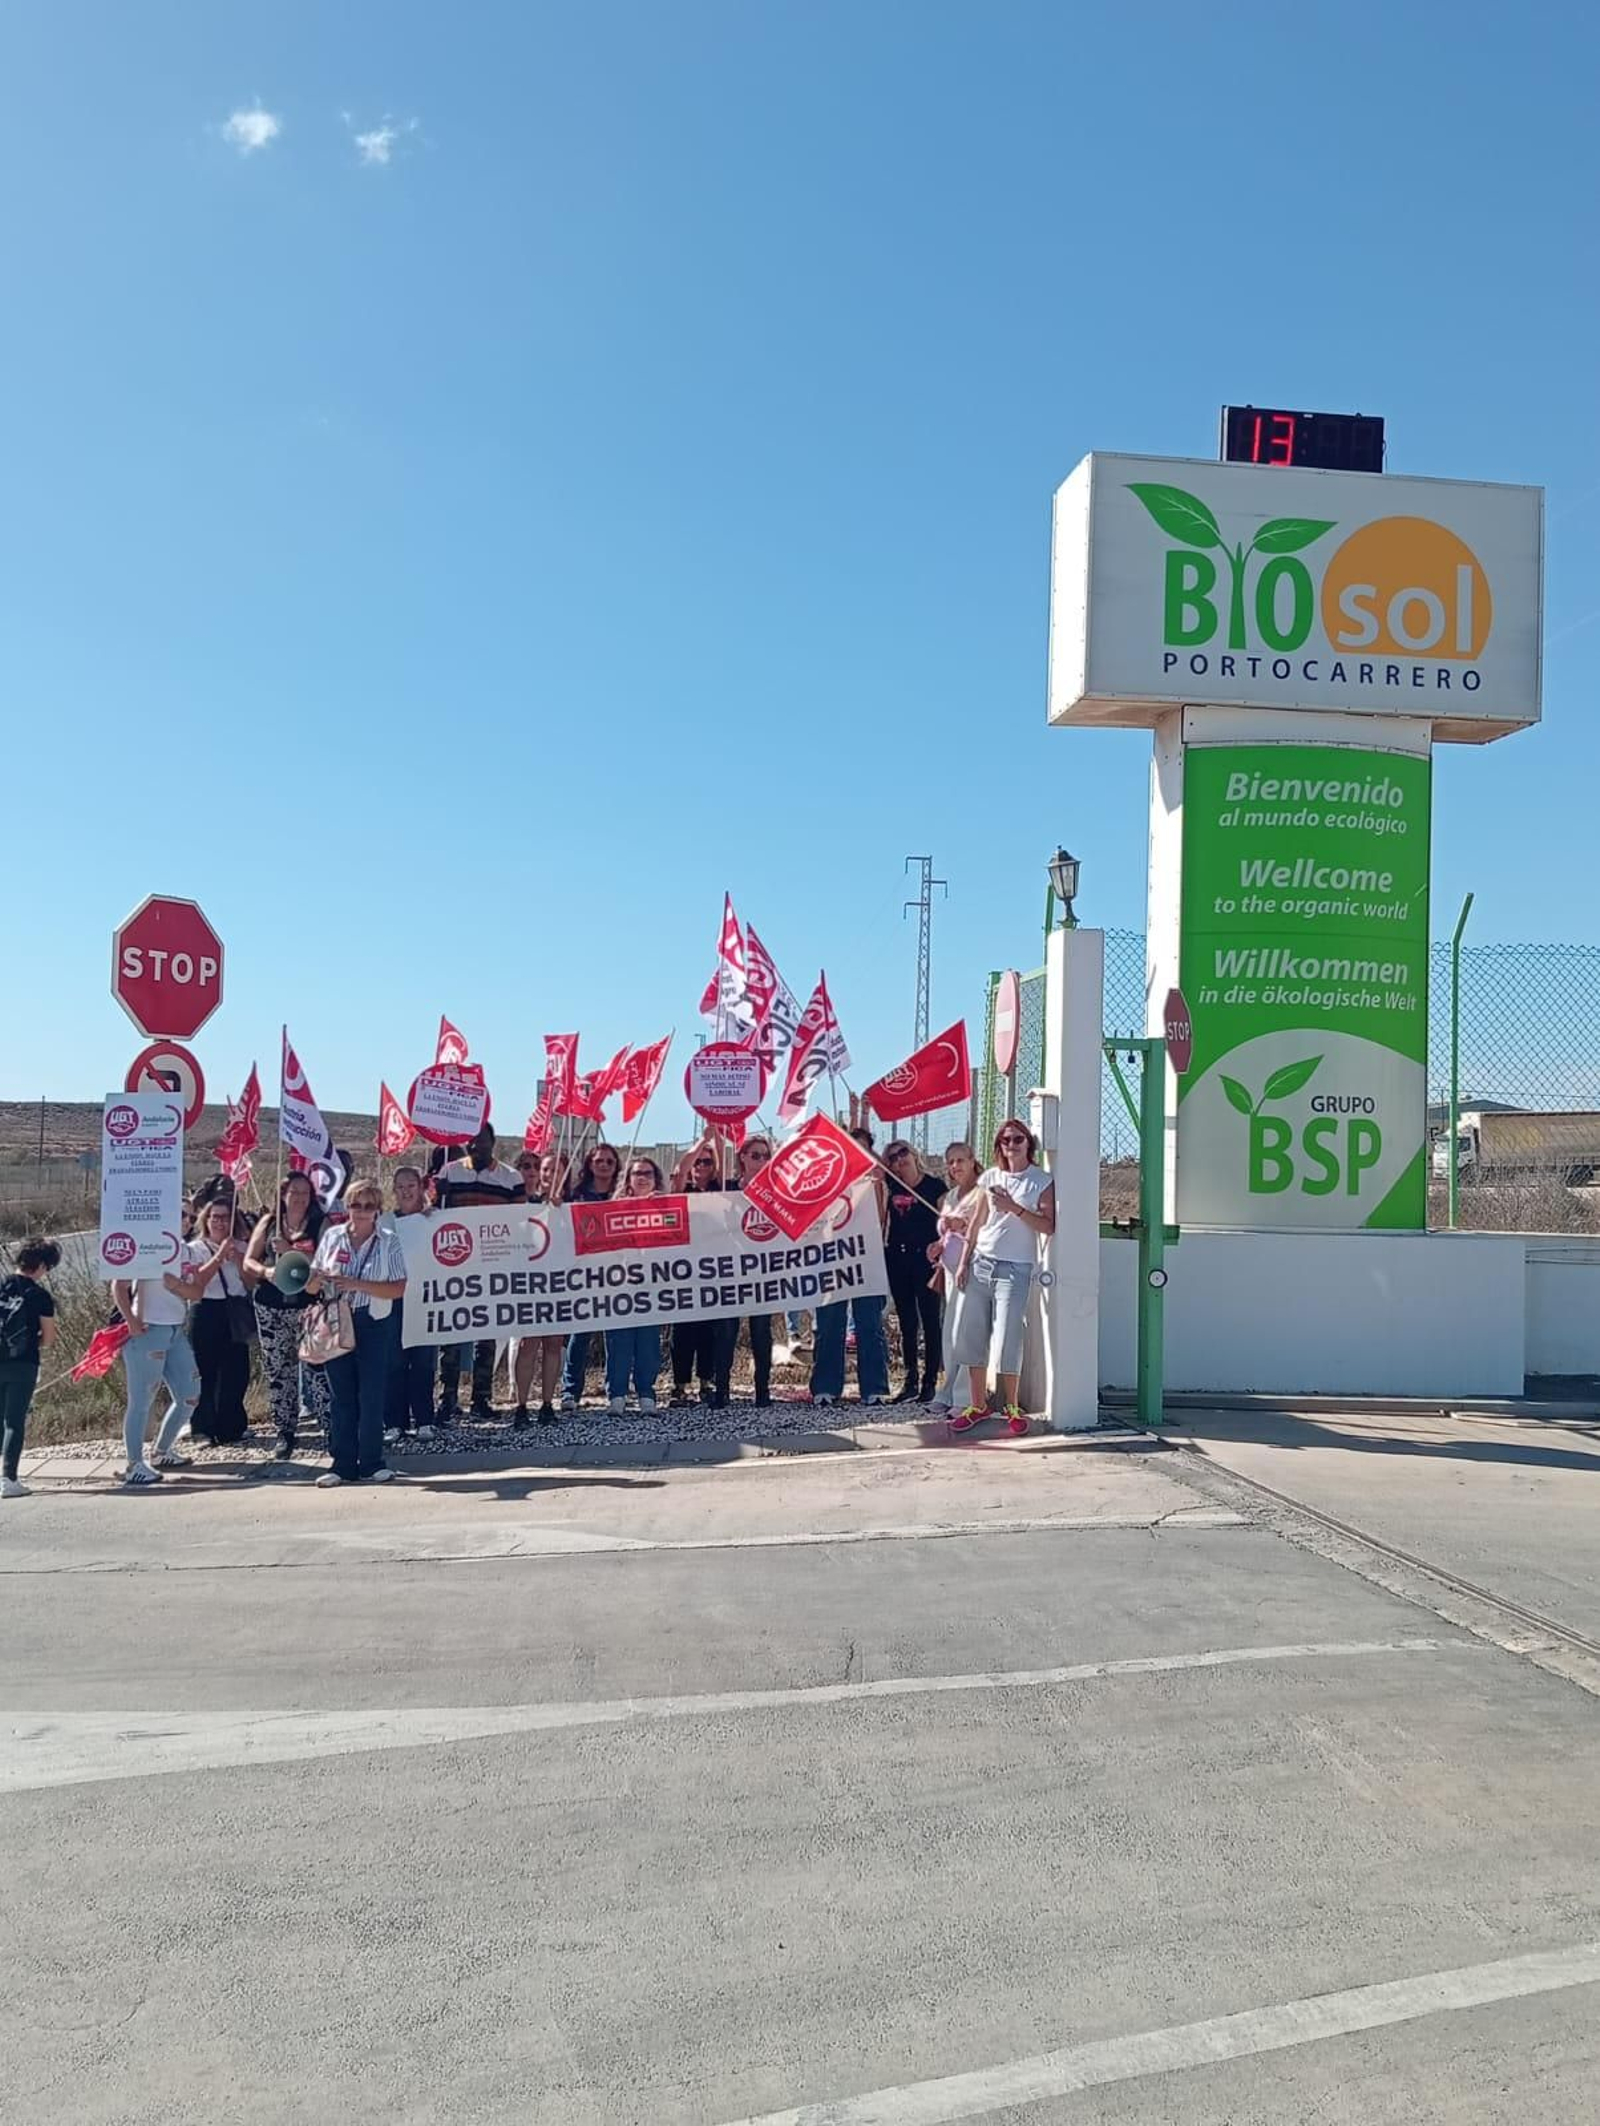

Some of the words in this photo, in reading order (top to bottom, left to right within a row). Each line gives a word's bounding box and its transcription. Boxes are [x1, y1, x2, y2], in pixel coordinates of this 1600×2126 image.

[1252, 415, 1295, 467] 13
[1163, 652, 1482, 691] PORTOCARRERO
[1225, 772, 1404, 808] Bienvenido
[1218, 808, 1240, 827] al
[1243, 808, 1319, 827] mundo
[1324, 811, 1407, 835] ecológico
[1239, 859, 1393, 893] Wellcome
[1214, 896, 1235, 914] to
[1241, 895, 1276, 914] the
[1281, 896, 1359, 918] organic
[1362, 902, 1408, 920] world
[122, 947, 218, 987] STOP
[1214, 949, 1409, 985] Willkommen
[1199, 985, 1218, 1004] in
[1223, 985, 1256, 1004] die
[1262, 986, 1381, 1010] ökologische
[1384, 990, 1417, 1011] Welt
[1167, 1021, 1190, 1042] STOP
[1310, 1095, 1375, 1114] GRUPO
[1248, 1115, 1383, 1196] BSP
[479, 1223, 511, 1239] FICA
[609, 1213, 664, 1231] CCOO
[437, 1229, 468, 1251] UGT
[422, 1274, 483, 1304] ¡LOS
[489, 1263, 645, 1296] DERECHOS
[651, 1259, 692, 1283] NO
[698, 1254, 734, 1279] SE
[740, 1234, 866, 1276] PIERDEN!
[427, 1304, 490, 1333] ¡LOS
[496, 1291, 651, 1326] DERECHOS
[657, 1286, 694, 1312] SE
[700, 1263, 865, 1308] DEFIENDEN!
